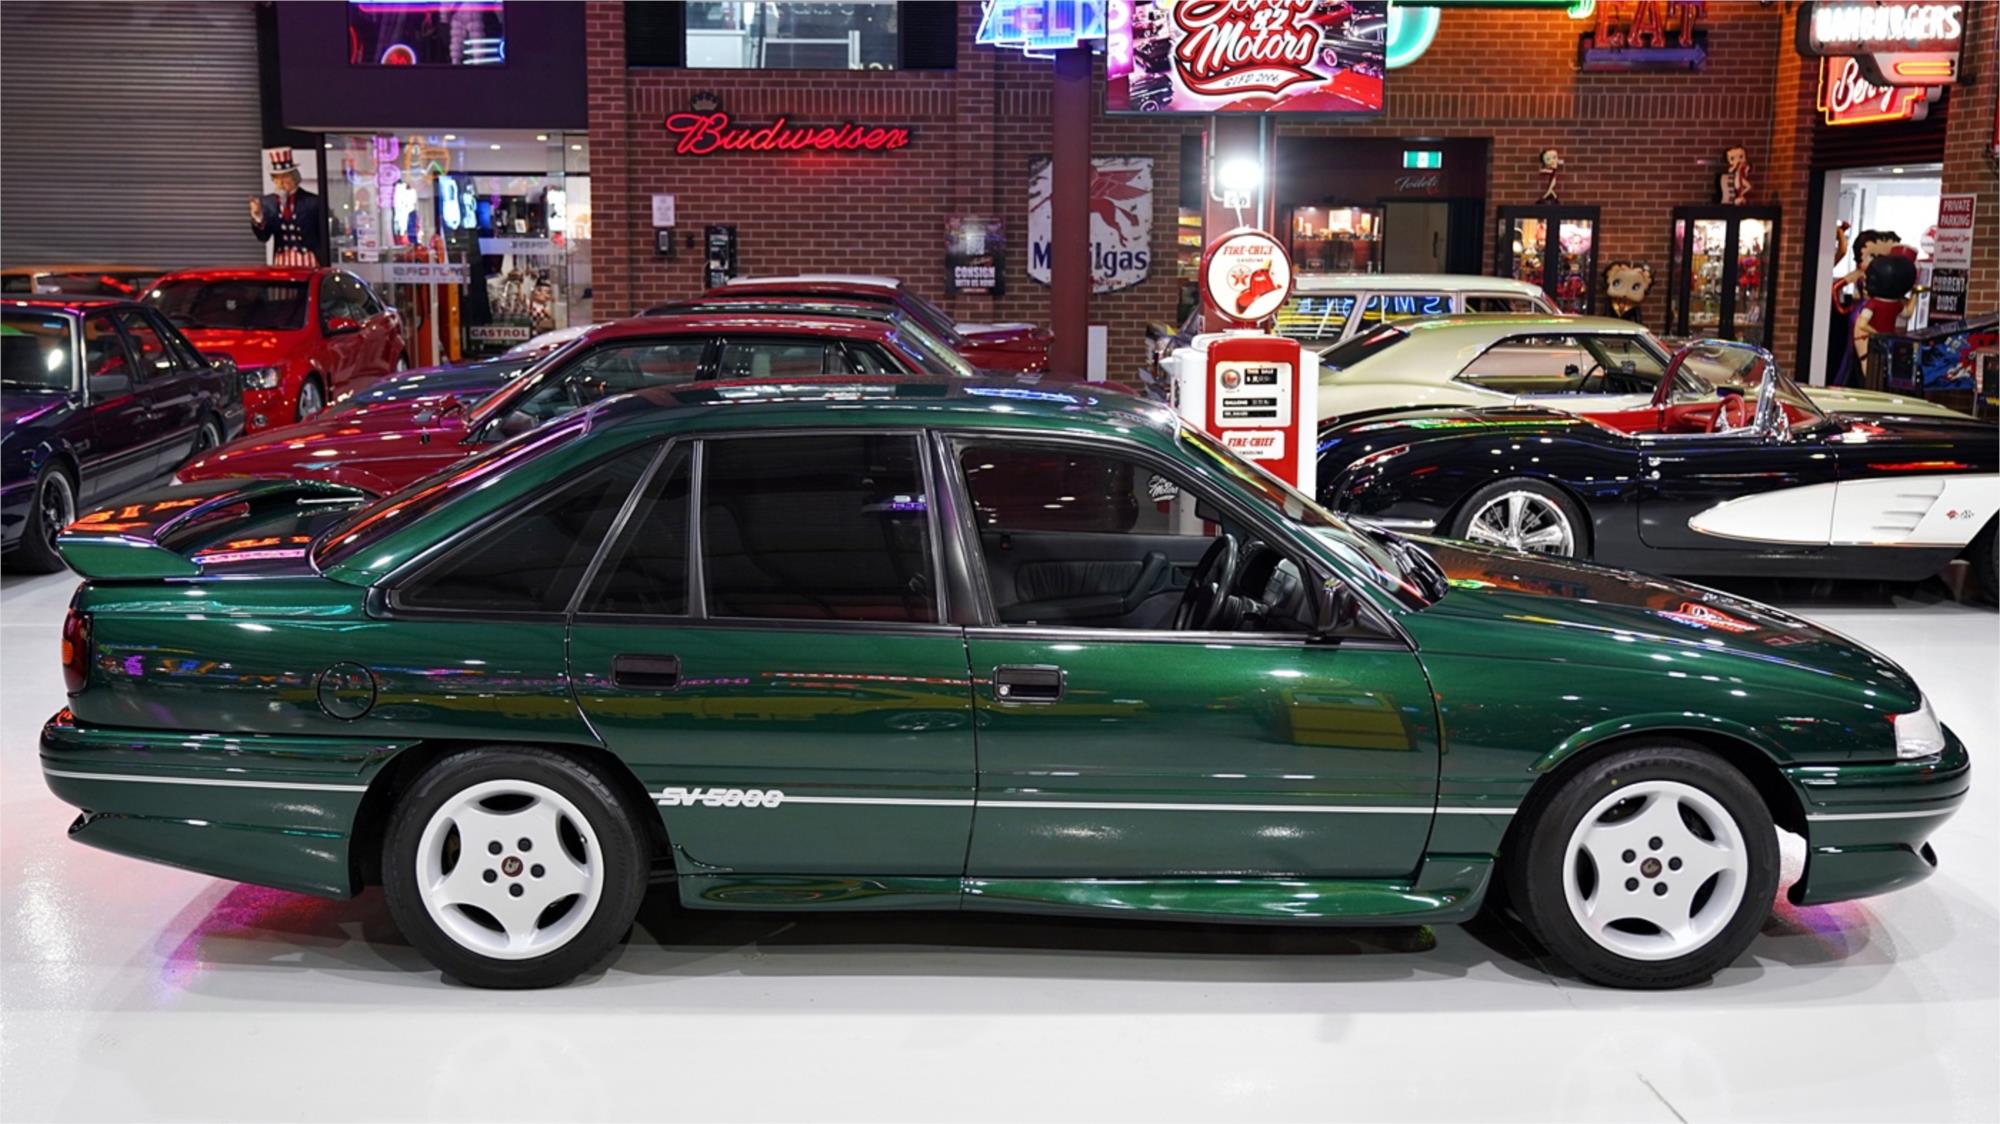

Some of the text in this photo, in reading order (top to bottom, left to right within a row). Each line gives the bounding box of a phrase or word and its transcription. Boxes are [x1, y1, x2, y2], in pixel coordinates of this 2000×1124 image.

[1595, 1, 1706, 47] EAT
[1816, 5, 1962, 42] HAMBURGERS
[1182, 21, 1312, 74] Motors
[665, 113, 909, 154] Budweiser
[1941, 214, 1970, 227] PARKING
[1943, 200, 1971, 212] PRIVATE
[471, 328, 528, 338] CASTROL
